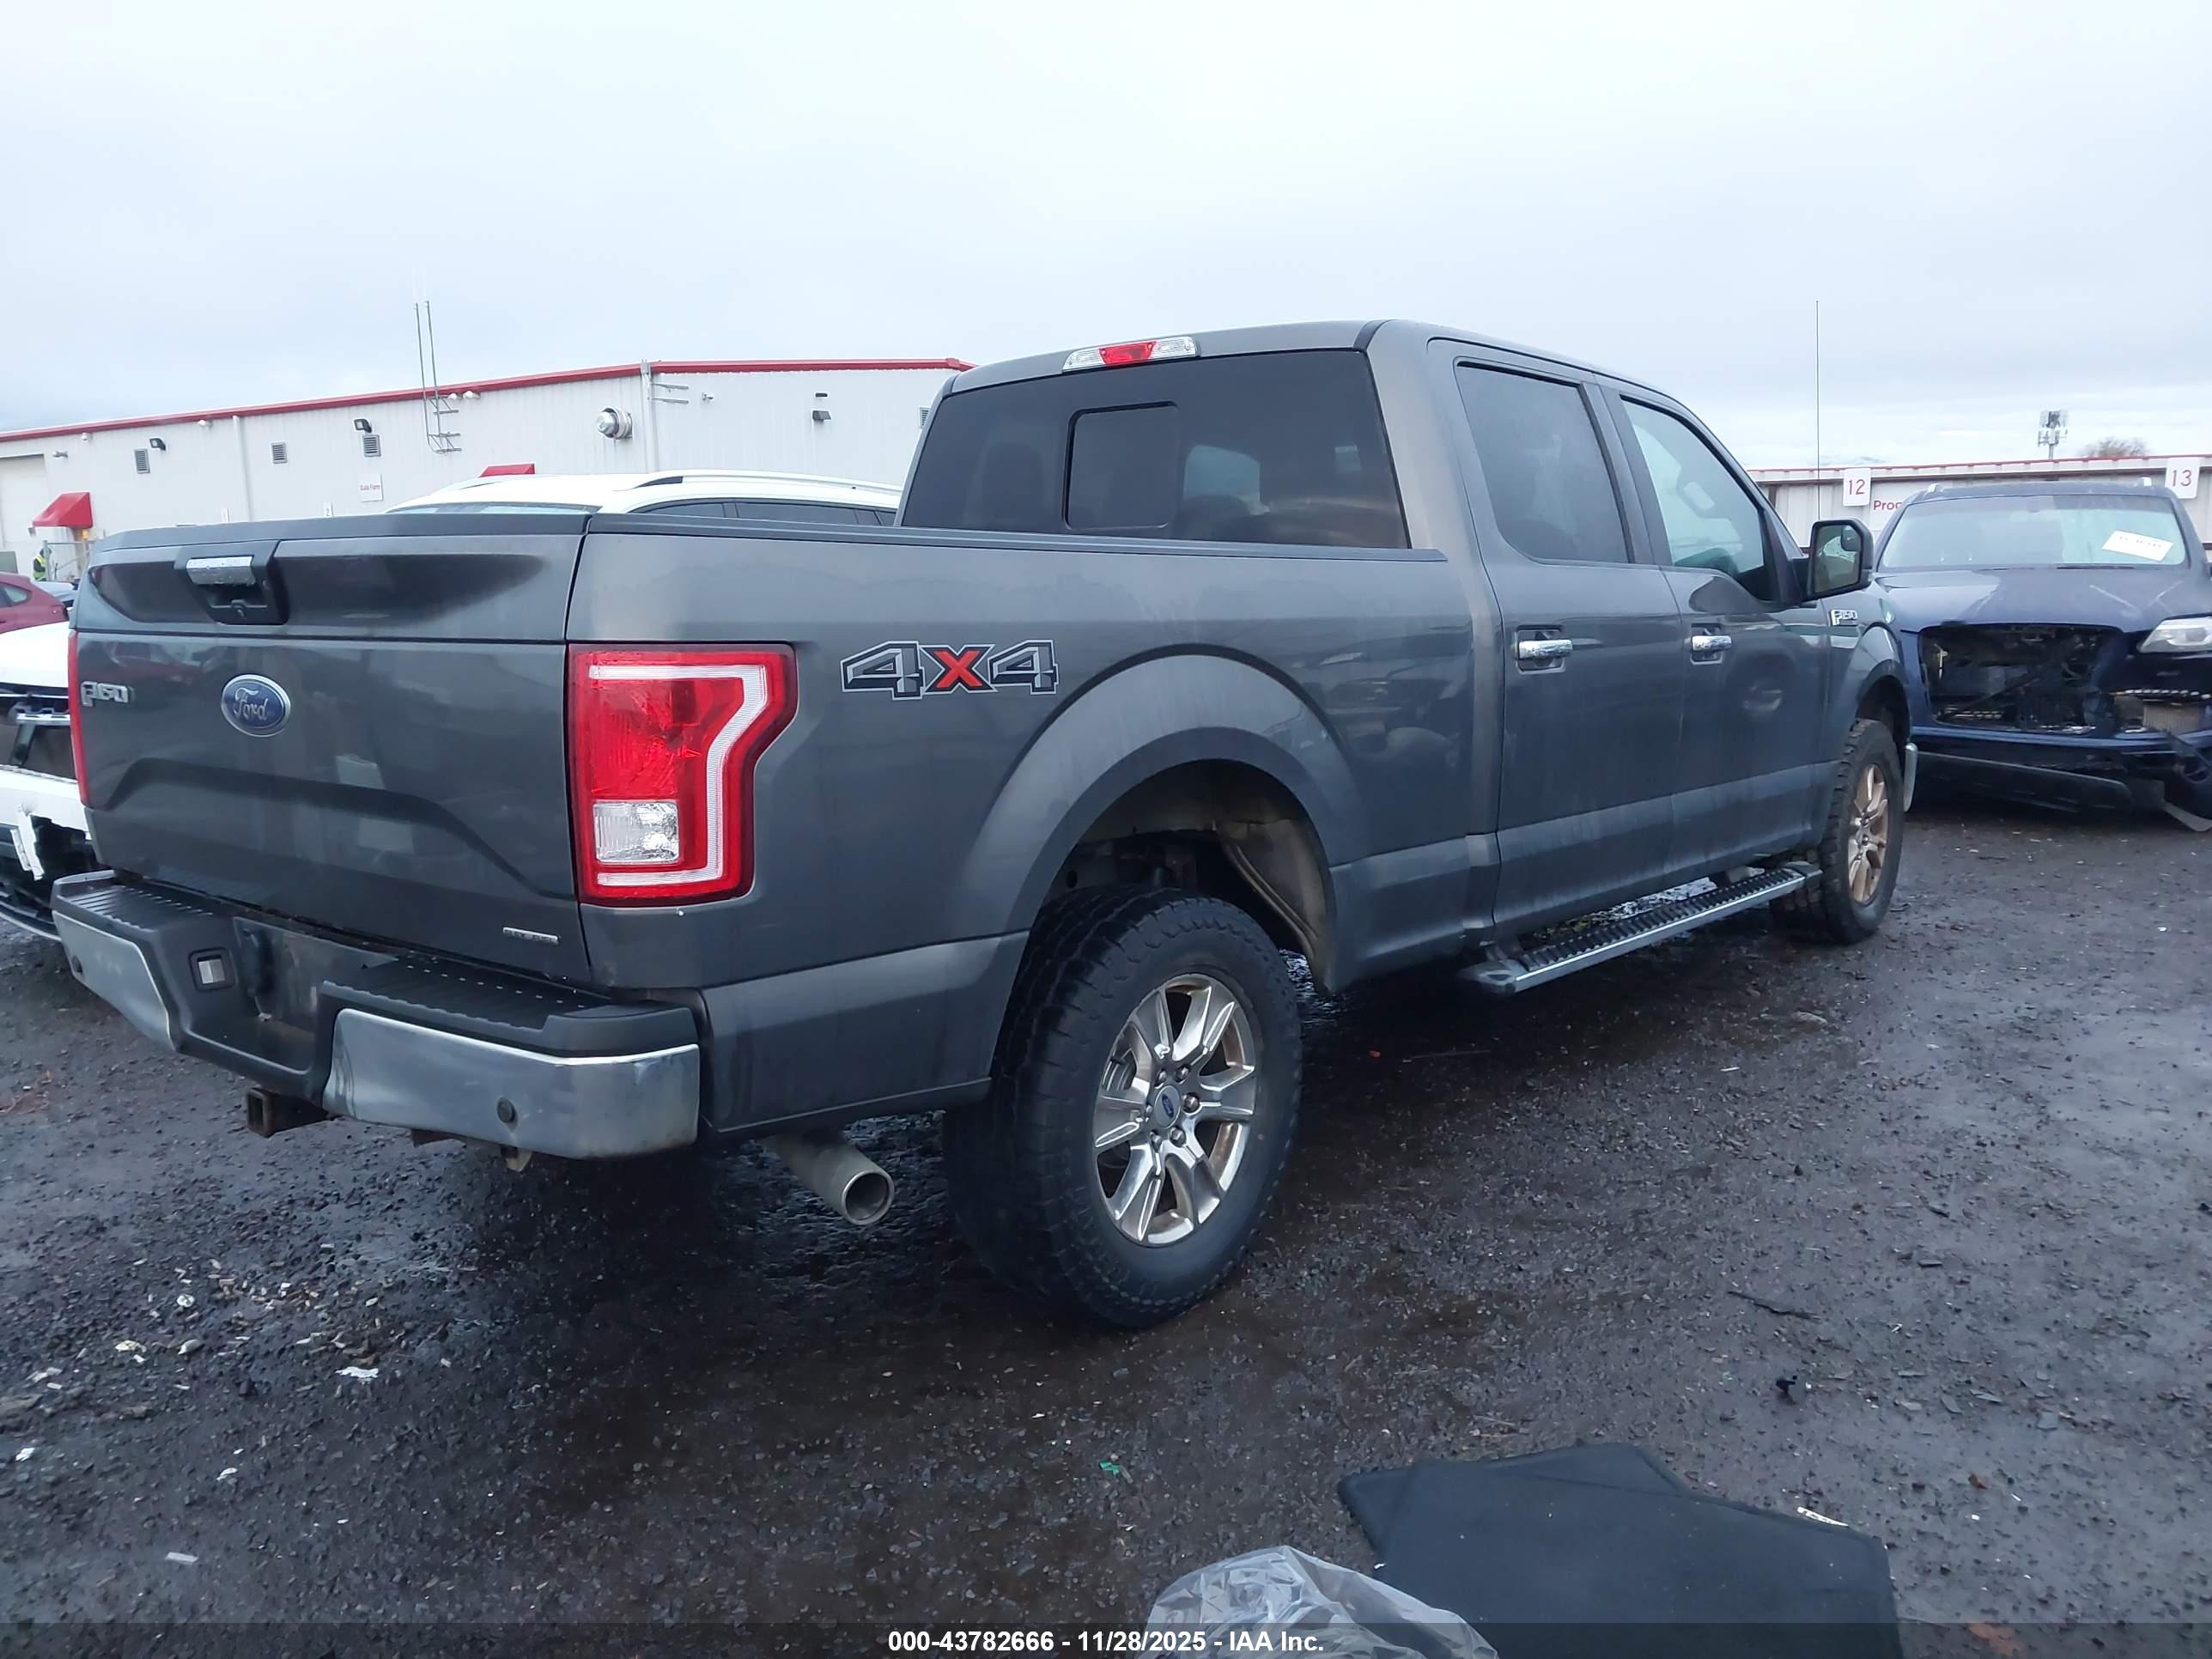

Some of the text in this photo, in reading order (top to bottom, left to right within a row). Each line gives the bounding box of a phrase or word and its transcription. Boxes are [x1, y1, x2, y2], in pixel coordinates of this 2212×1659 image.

[1848, 478, 1866, 495] 12
[2172, 469, 2192, 488] 13
[233, 687, 269, 721] Ford
